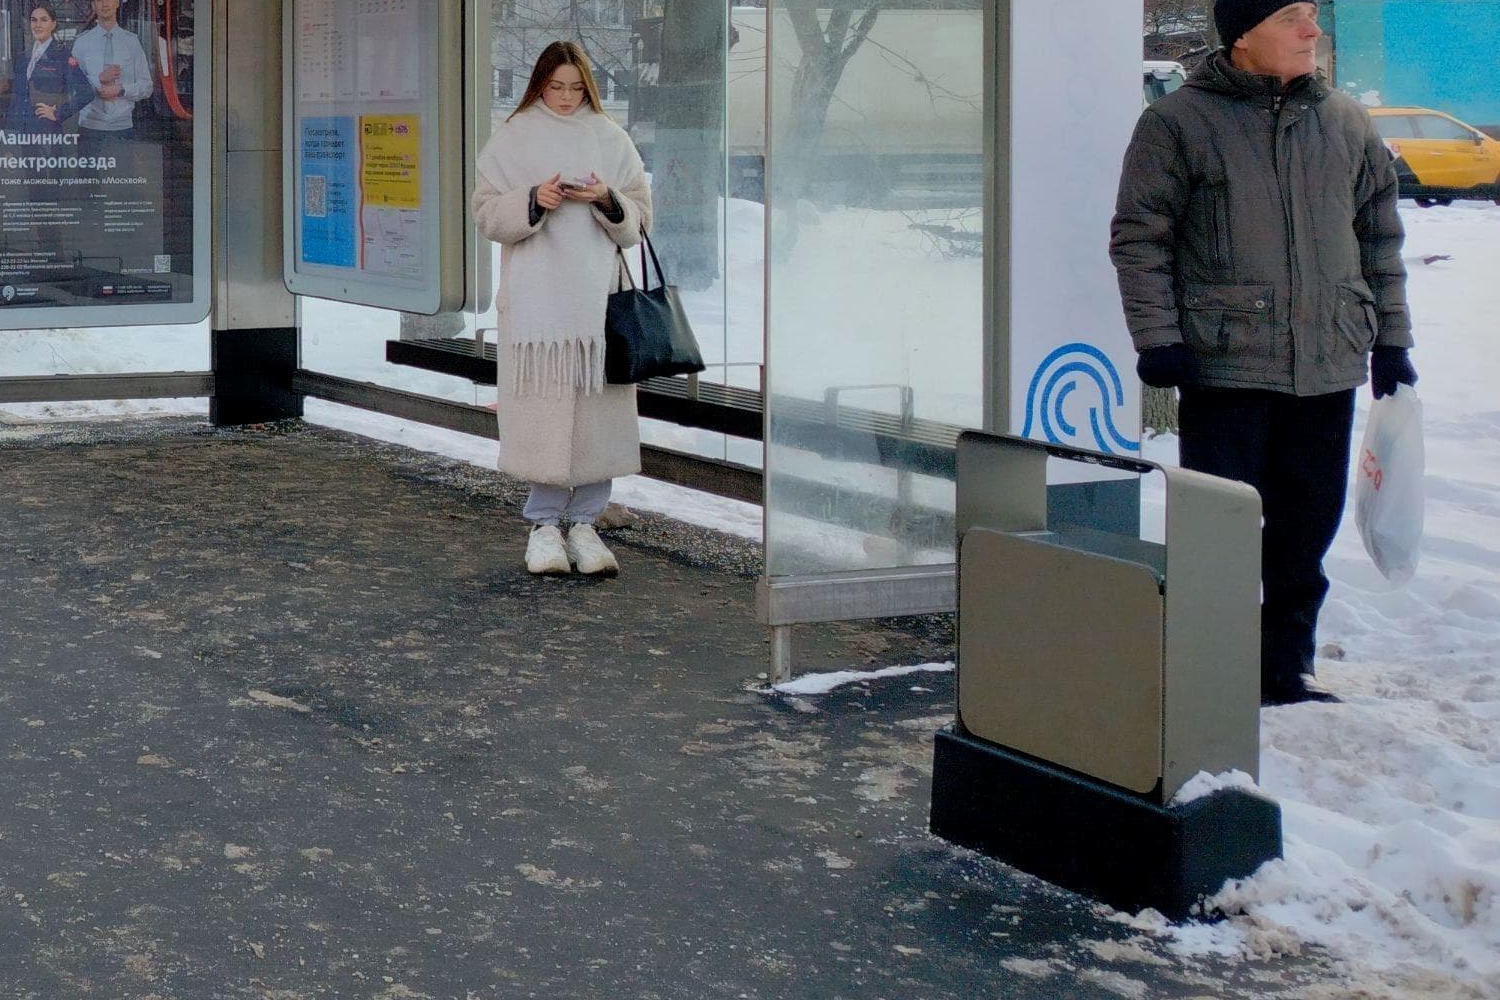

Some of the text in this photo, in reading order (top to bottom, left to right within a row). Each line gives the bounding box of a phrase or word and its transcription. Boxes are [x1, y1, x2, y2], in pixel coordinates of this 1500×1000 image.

[1, 177, 21, 185] тоже
[23, 177, 58, 185] можешь
[59, 177, 100, 187] управлять
